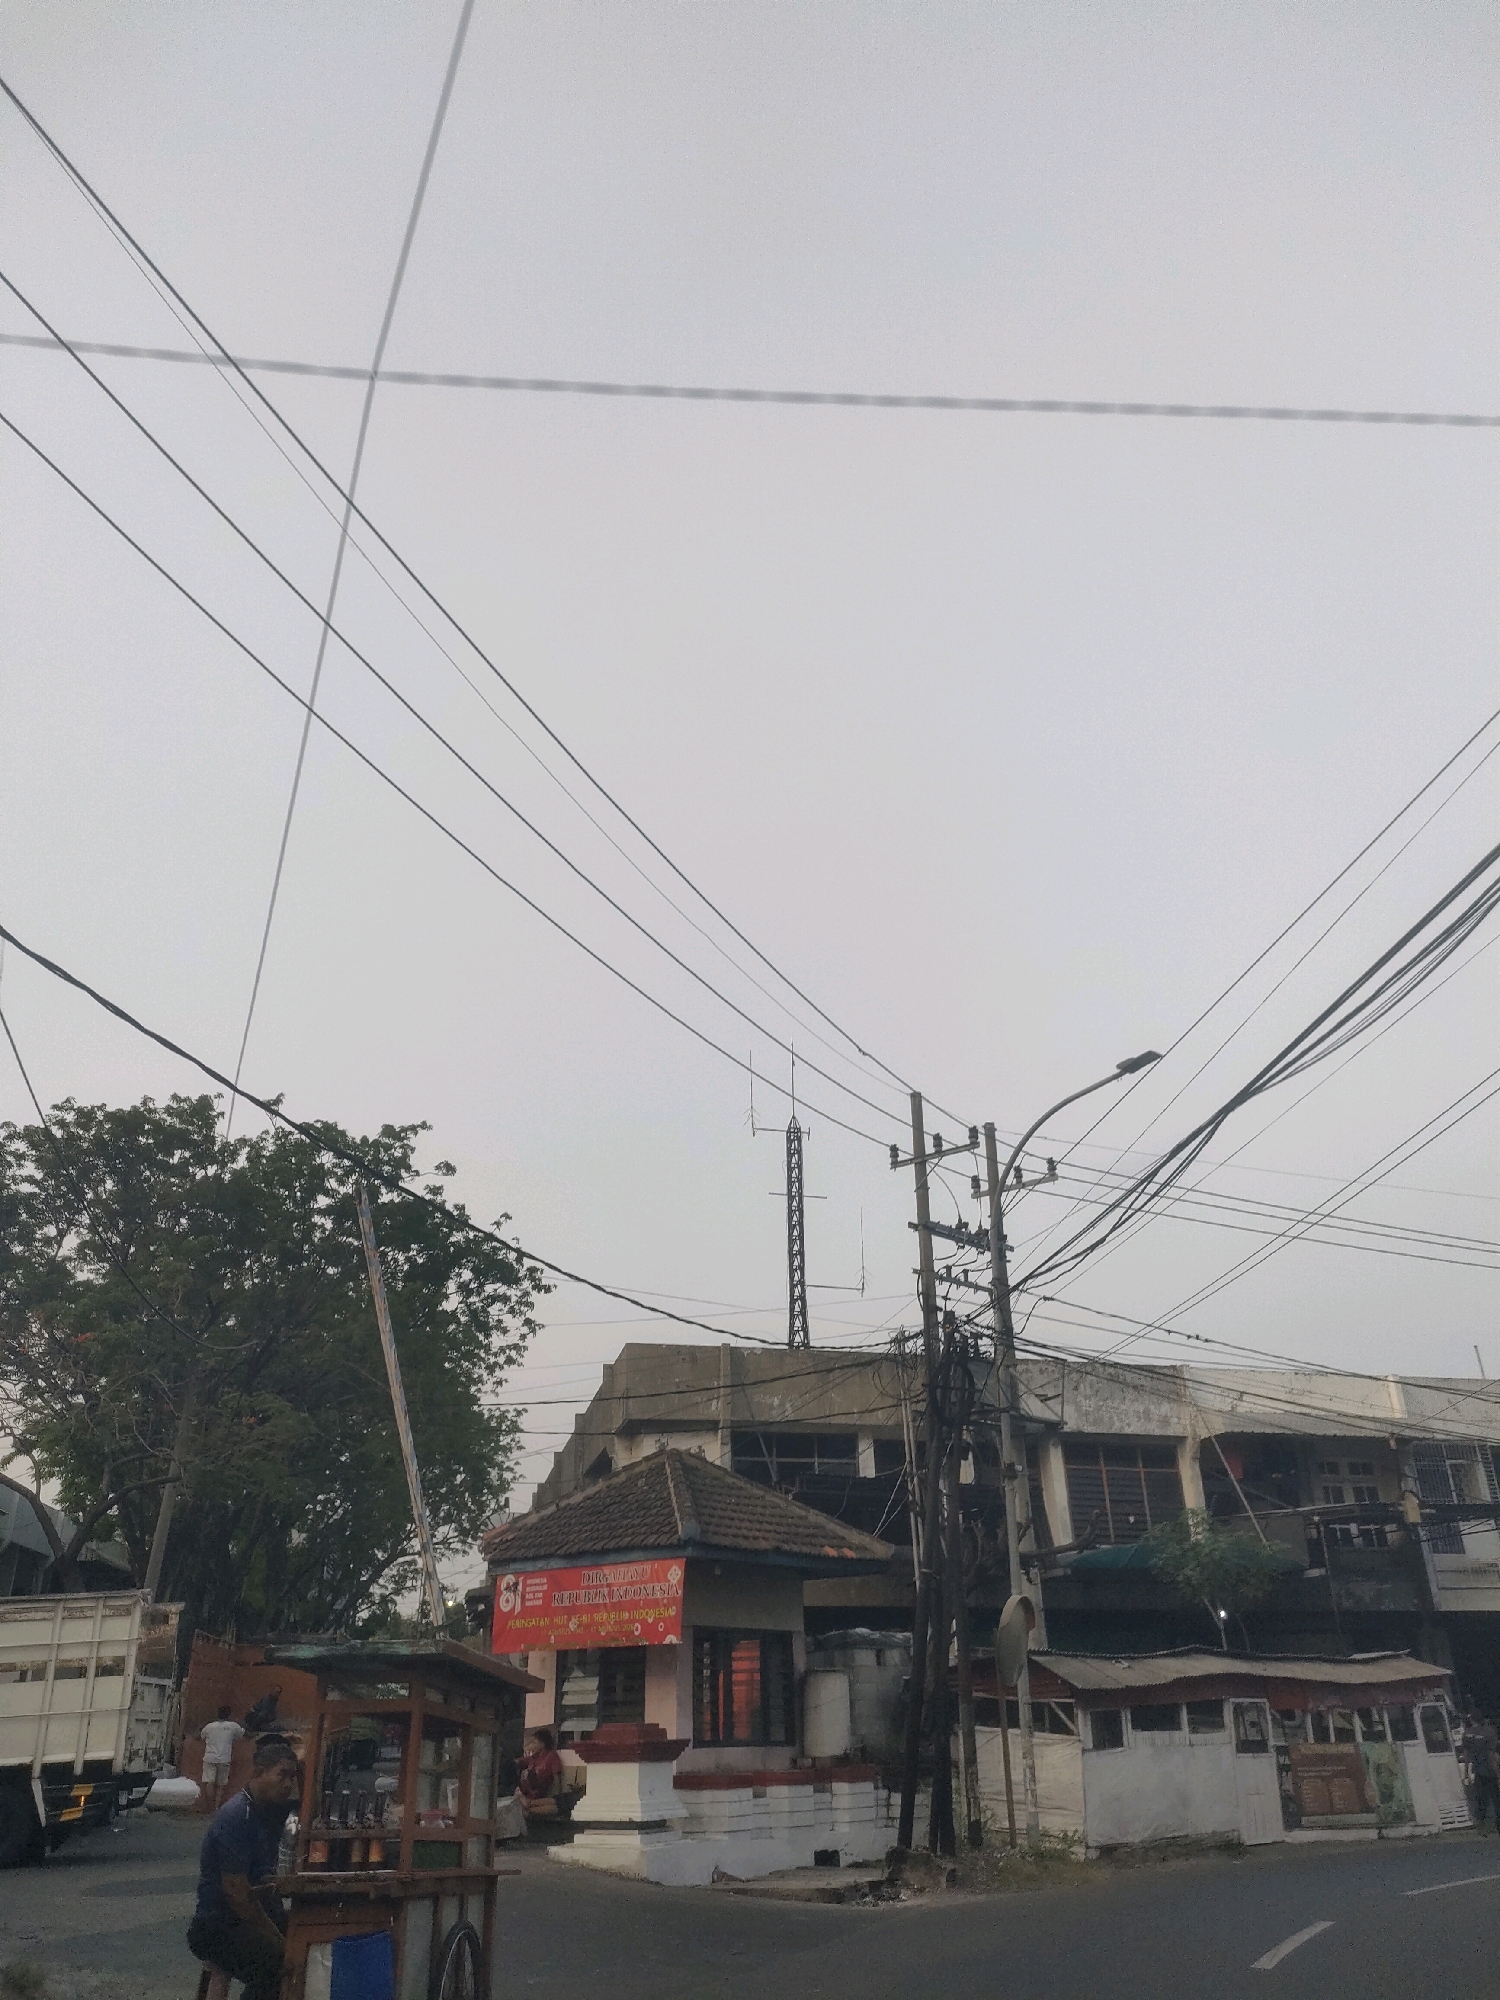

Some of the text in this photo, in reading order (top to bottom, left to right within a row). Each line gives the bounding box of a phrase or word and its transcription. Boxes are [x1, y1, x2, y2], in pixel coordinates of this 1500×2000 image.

[581, 1564, 652, 1586] DIRGAHAYU
[552, 1587, 609, 1607] REPUBLIK
[611, 1582, 682, 1602] INDONESIA
[507, 1616, 549, 1629] PERINGATAN
[553, 1614, 568, 1626] HUT
[630, 1606, 673, 1619] INDONESIA
